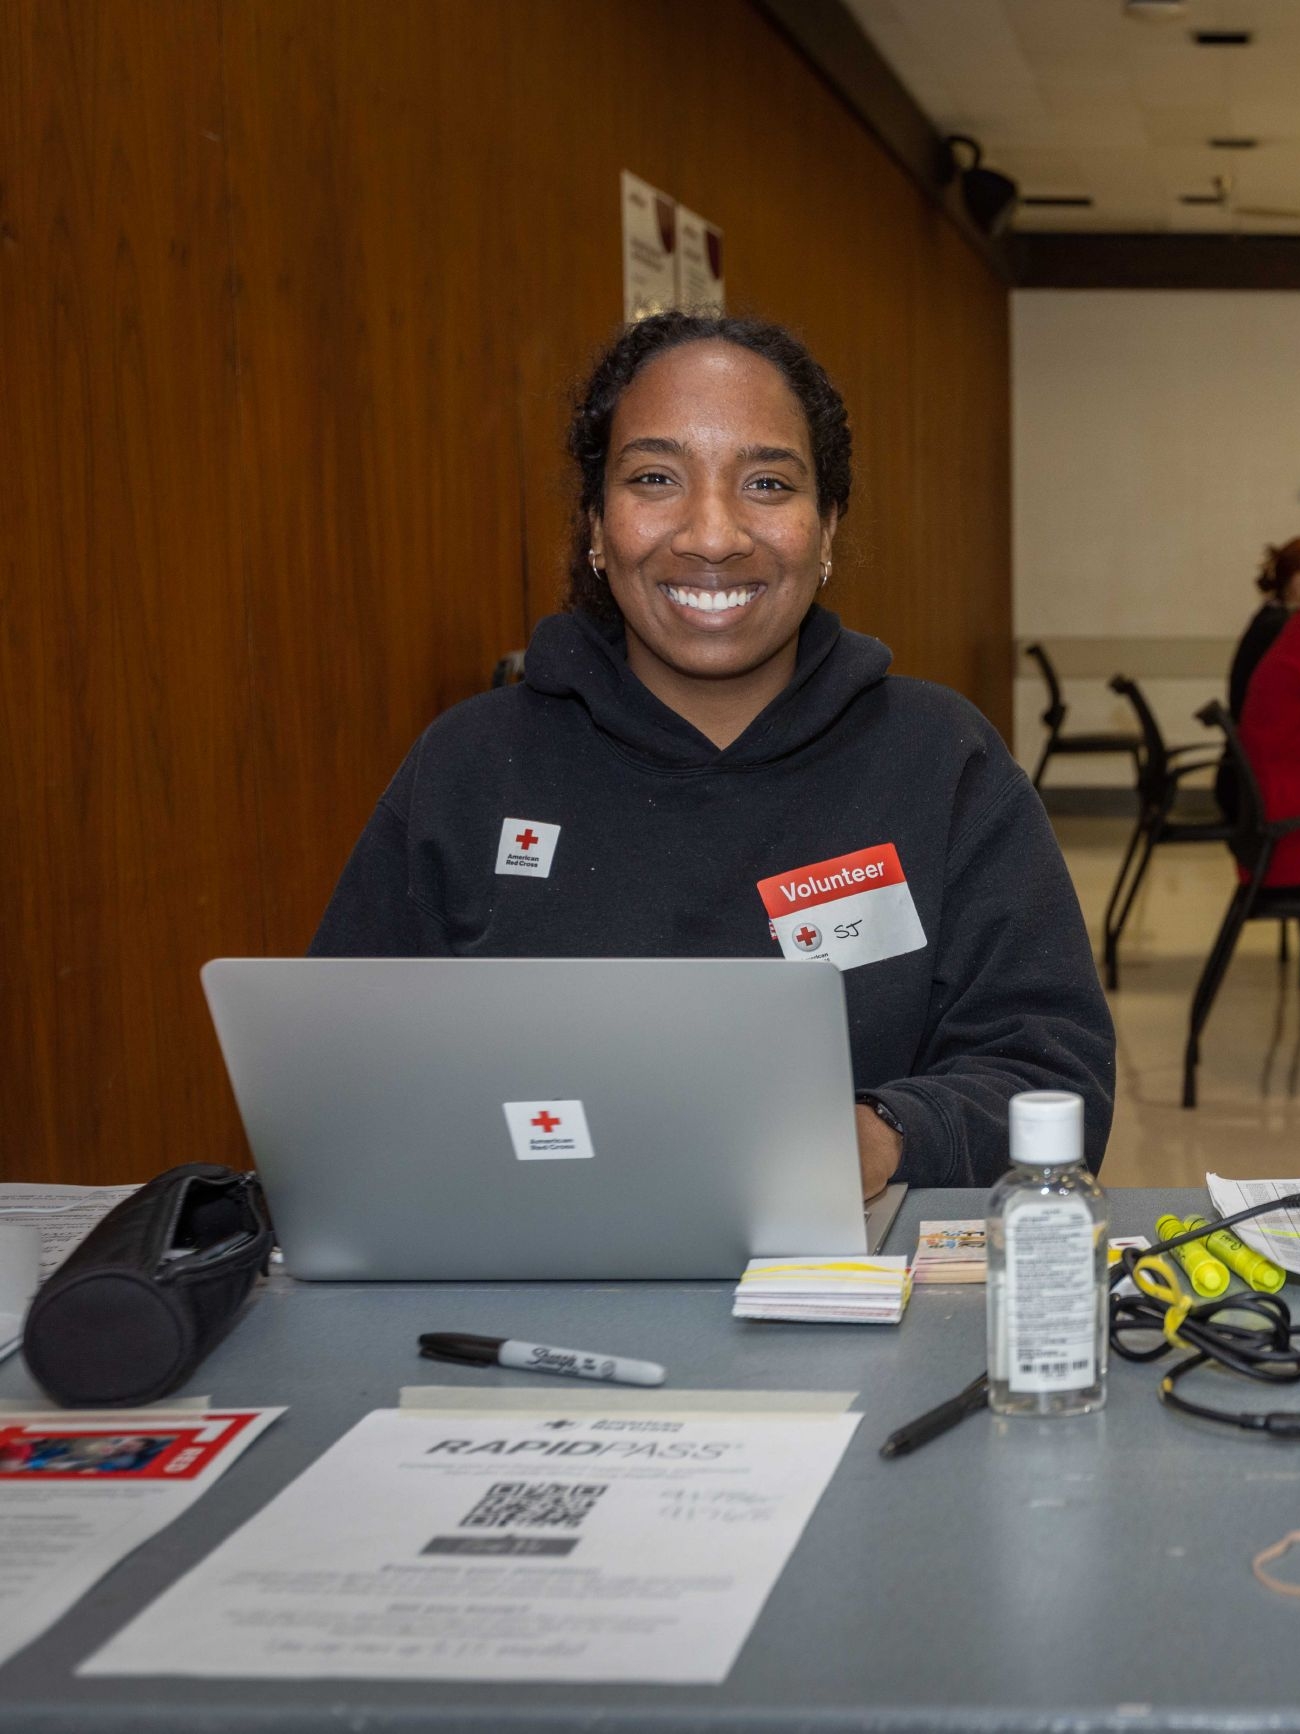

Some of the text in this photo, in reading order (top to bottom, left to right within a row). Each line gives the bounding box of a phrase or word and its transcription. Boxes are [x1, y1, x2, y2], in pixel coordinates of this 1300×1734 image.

[507, 853, 540, 862] American
[519, 860, 538, 868] Cross
[780, 861, 884, 902] Volunteer
[834, 919, 863, 939] SJ
